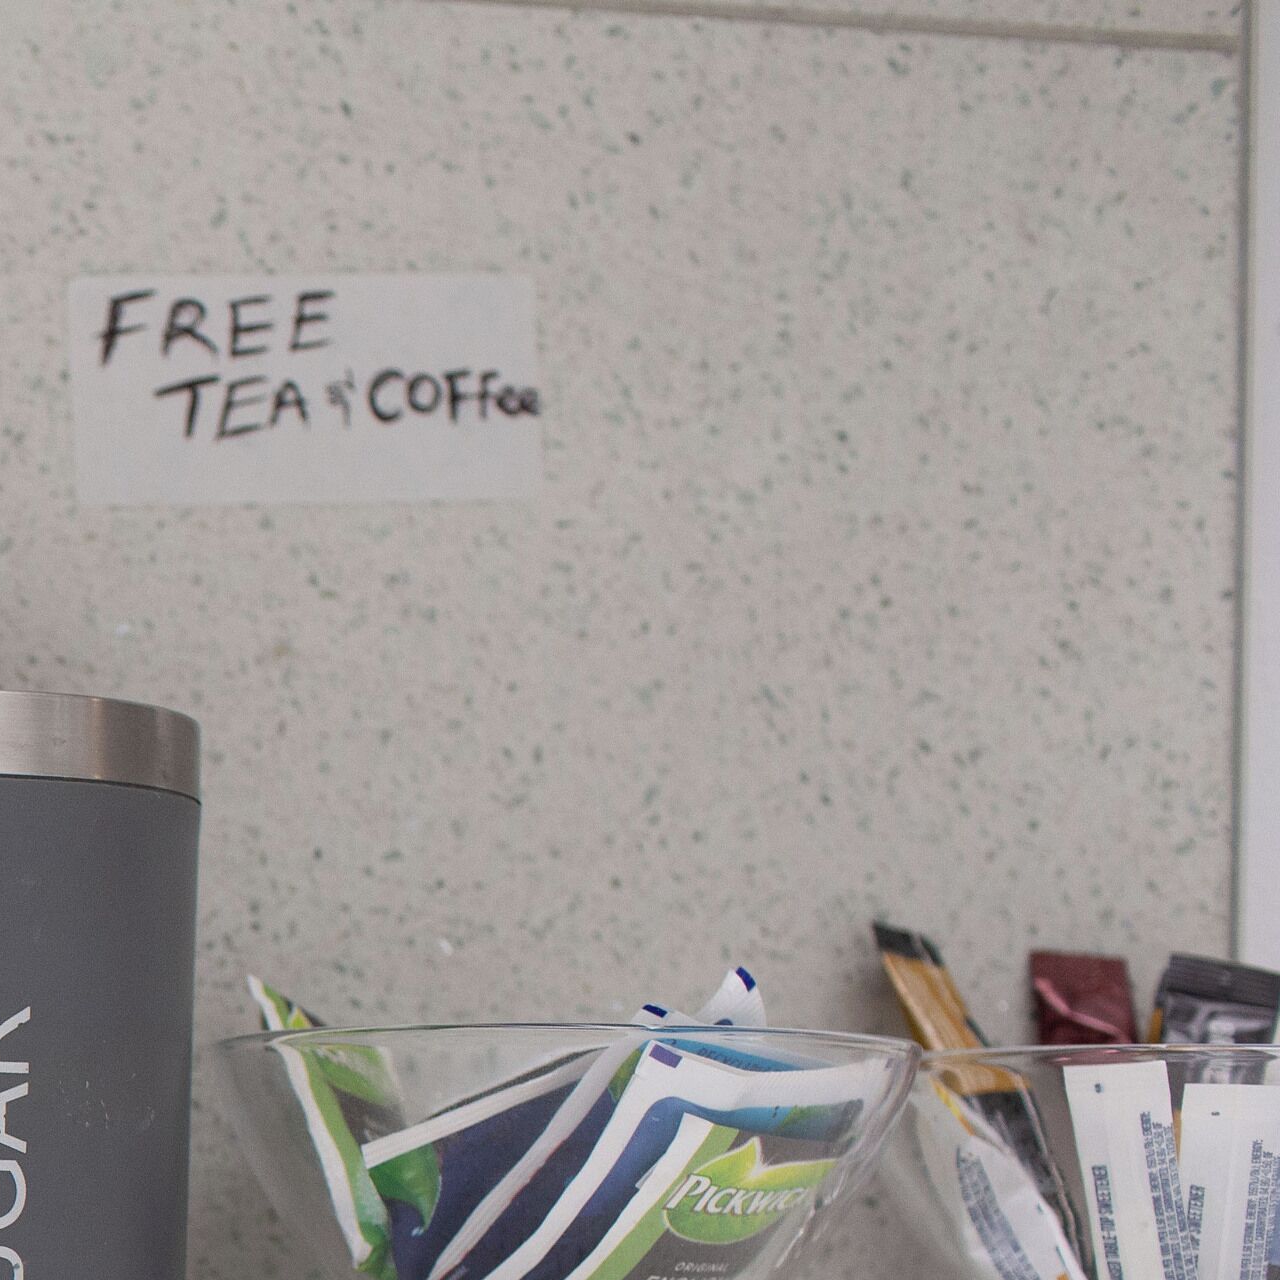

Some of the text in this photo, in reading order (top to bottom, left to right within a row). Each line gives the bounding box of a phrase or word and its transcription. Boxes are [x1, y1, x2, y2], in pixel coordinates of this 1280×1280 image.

[96, 288, 336, 365] FREE
[154, 375, 312, 441] TEA
[1092, 1165, 1114, 1215] SWEETENER
